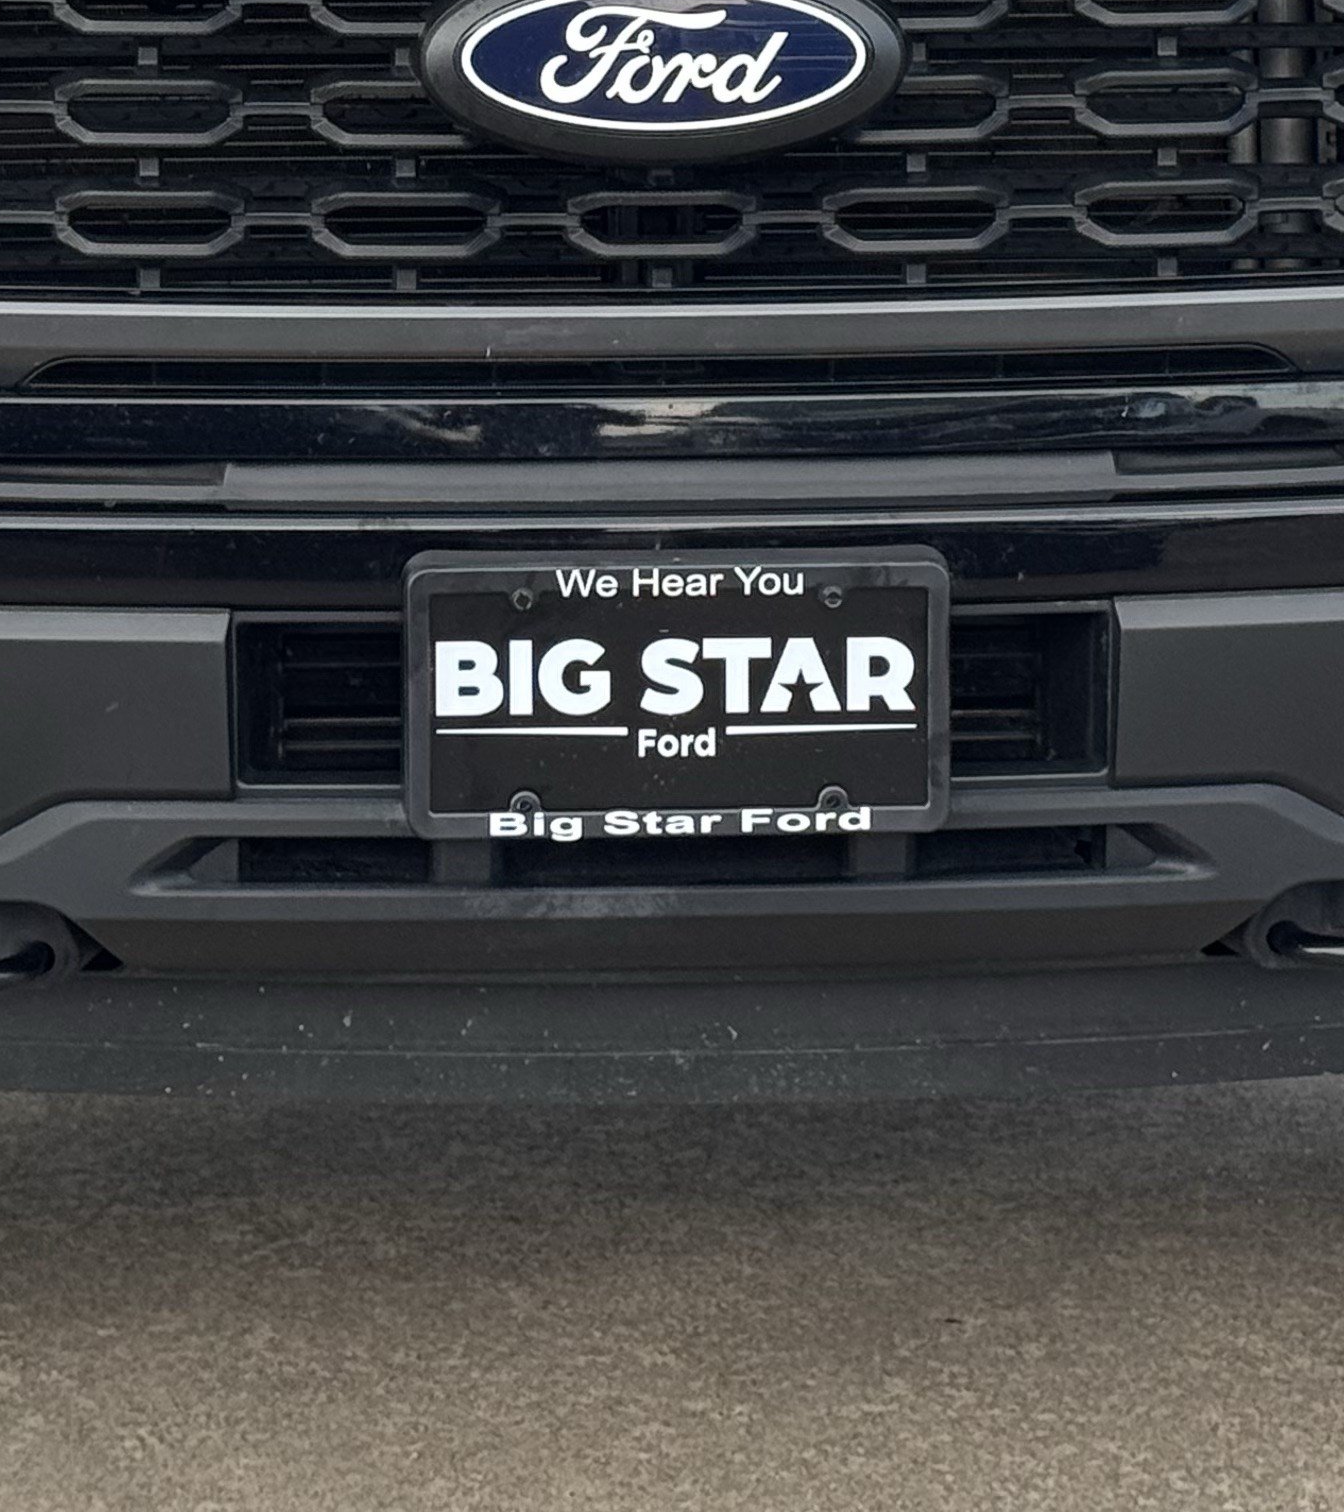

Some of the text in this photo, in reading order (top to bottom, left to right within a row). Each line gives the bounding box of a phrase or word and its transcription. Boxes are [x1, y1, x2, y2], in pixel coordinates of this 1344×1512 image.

[540, 5, 790, 105] Ford
[555, 565, 805, 598] We Hear You
[435, 636, 916, 717] BIG STAR
[638, 727, 716, 758] Ford
[489, 806, 872, 842] Big Star Ford
